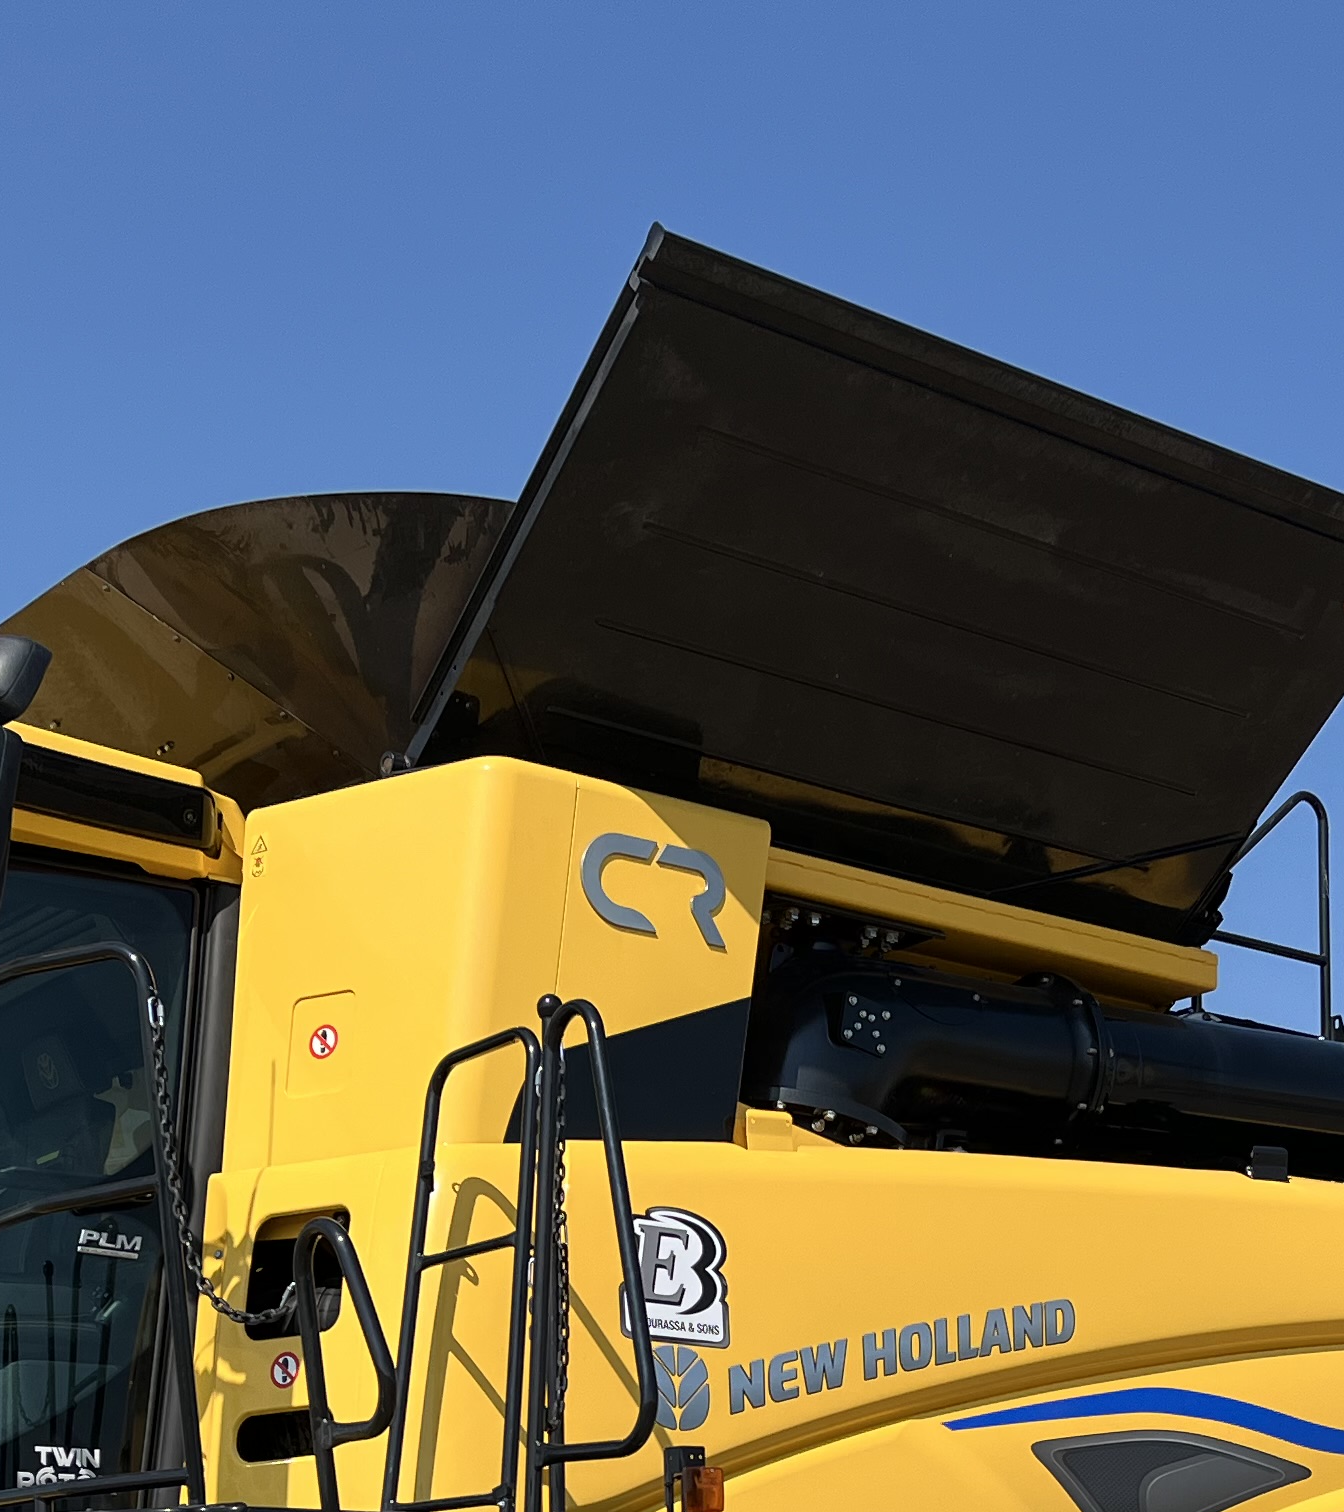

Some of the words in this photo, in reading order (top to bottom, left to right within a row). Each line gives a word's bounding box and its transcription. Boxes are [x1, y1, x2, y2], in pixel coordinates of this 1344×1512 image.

[581, 831, 727, 953] CR
[78, 1228, 143, 1251] PLM
[696, 1322, 721, 1336] SONS
[728, 1338, 848, 1415] NEW
[862, 1298, 1076, 1382] HOLLAND
[34, 1445, 100, 1469] TWIN
